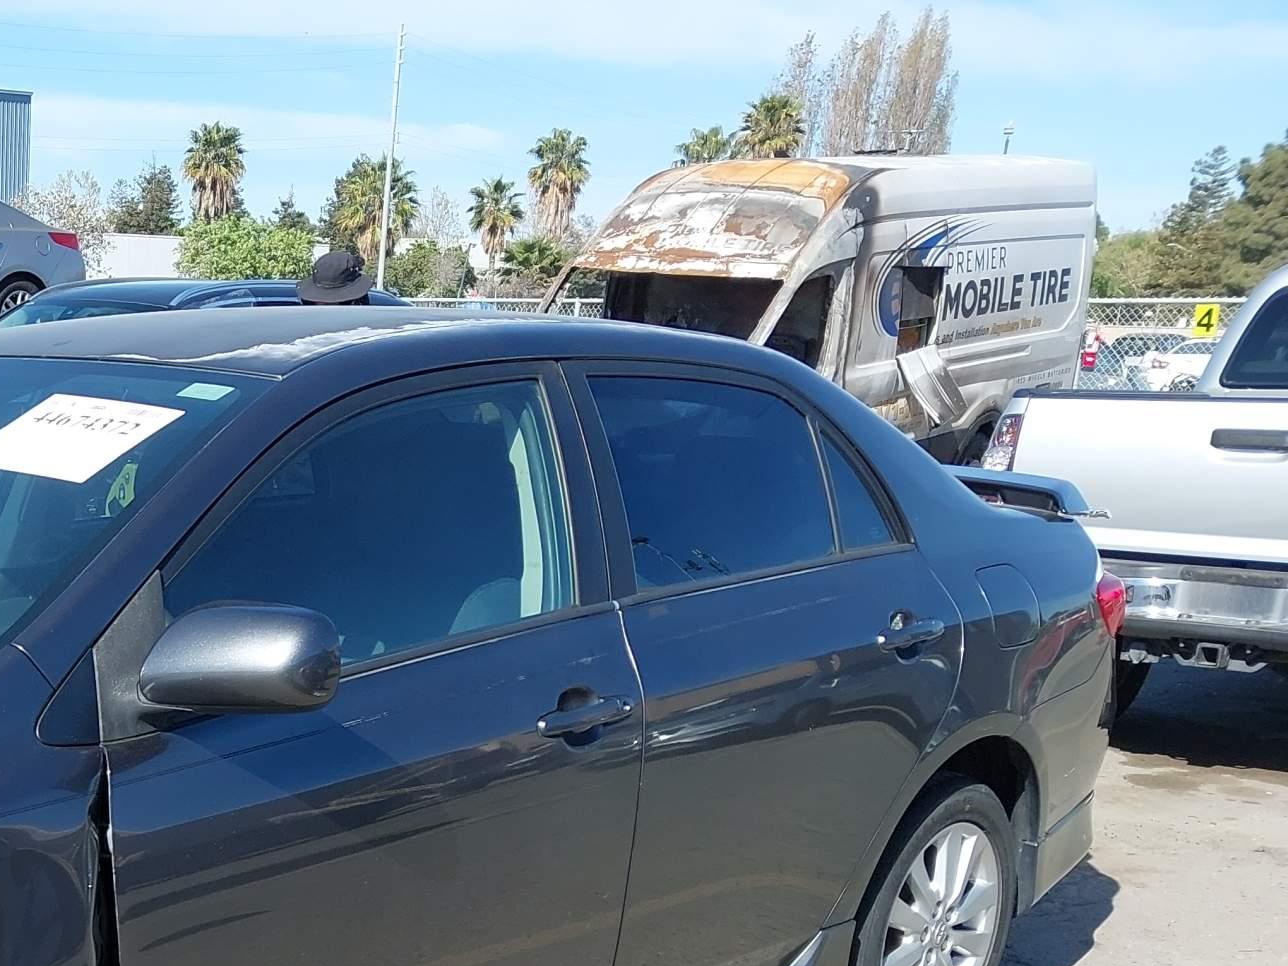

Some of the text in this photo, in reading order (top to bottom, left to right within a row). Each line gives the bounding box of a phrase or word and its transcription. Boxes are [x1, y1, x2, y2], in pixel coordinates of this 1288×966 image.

[945, 246, 1008, 276] PREMIER
[941, 267, 1072, 322] MOBILE TIRE
[1196, 307, 1215, 333] 4
[33, 411, 142, 435] 44674372
